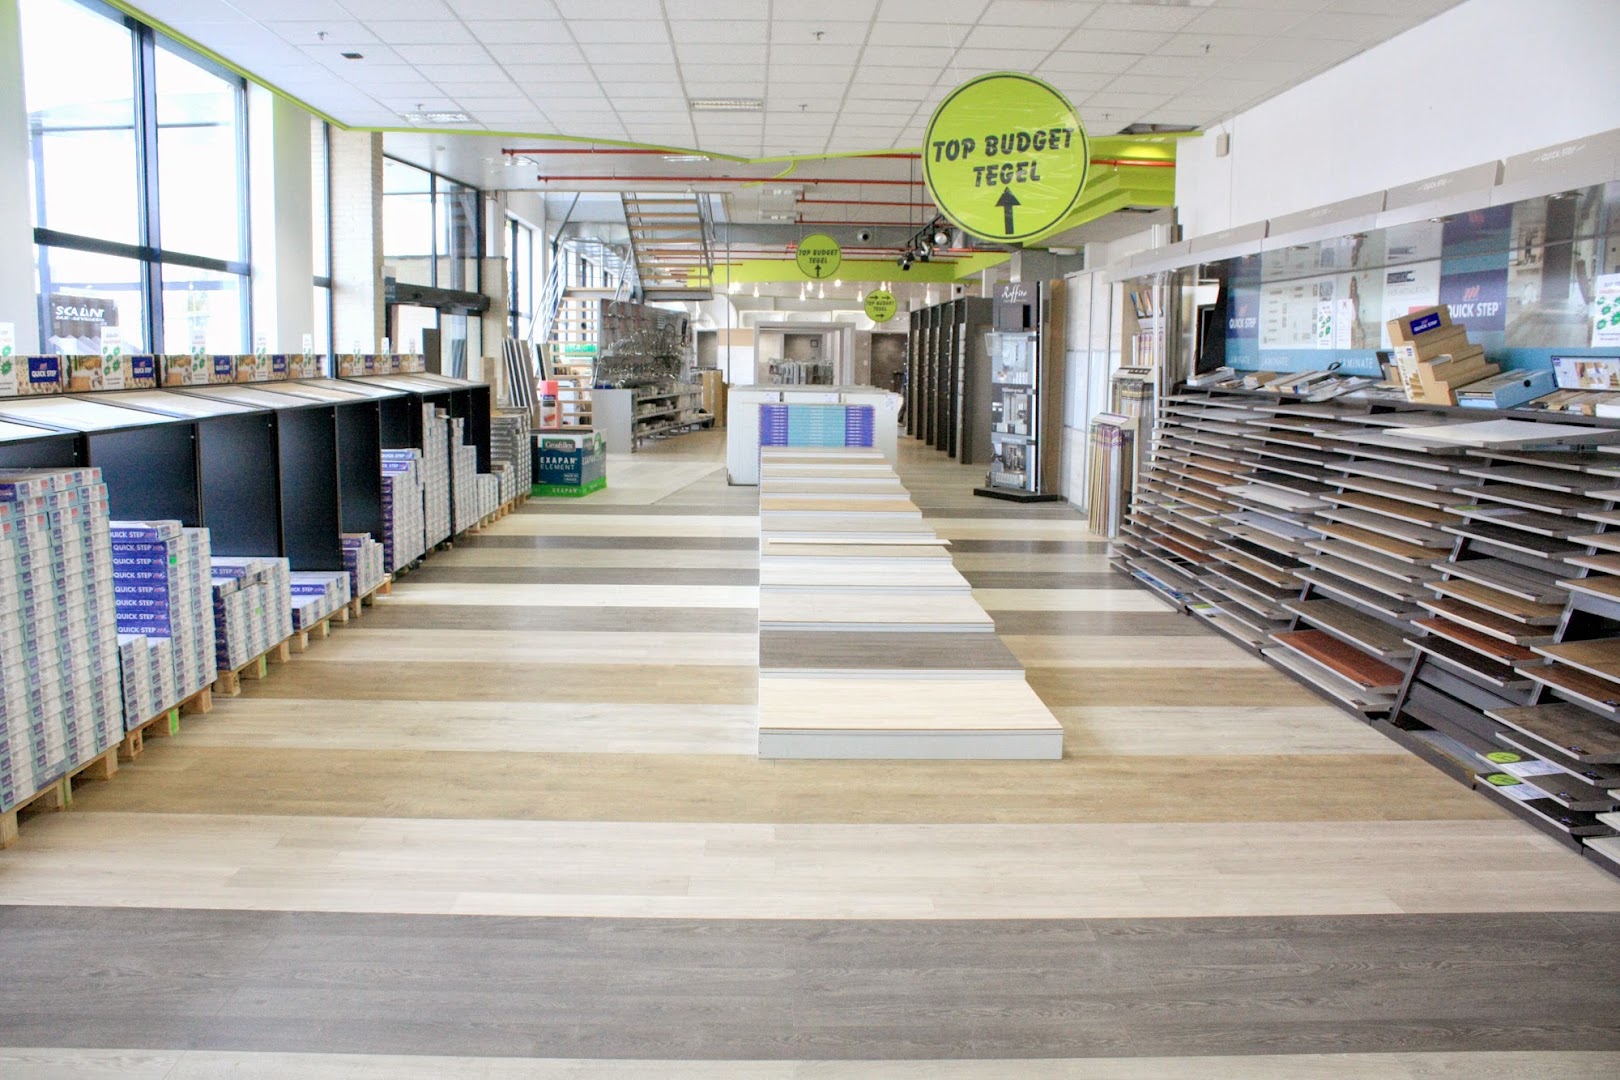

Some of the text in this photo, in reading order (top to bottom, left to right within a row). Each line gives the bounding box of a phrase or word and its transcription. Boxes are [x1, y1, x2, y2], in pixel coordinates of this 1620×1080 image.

[933, 128, 1074, 162] TOP BUDGET
[973, 160, 1041, 188] TEGEL
[812, 248, 838, 256] BUDGET
[1476, 301, 1499, 317] STEP
[128, 531, 145, 539] STEP
[115, 599, 154, 607] QUICK STEP
[117, 626, 157, 634] QUICK STEP
